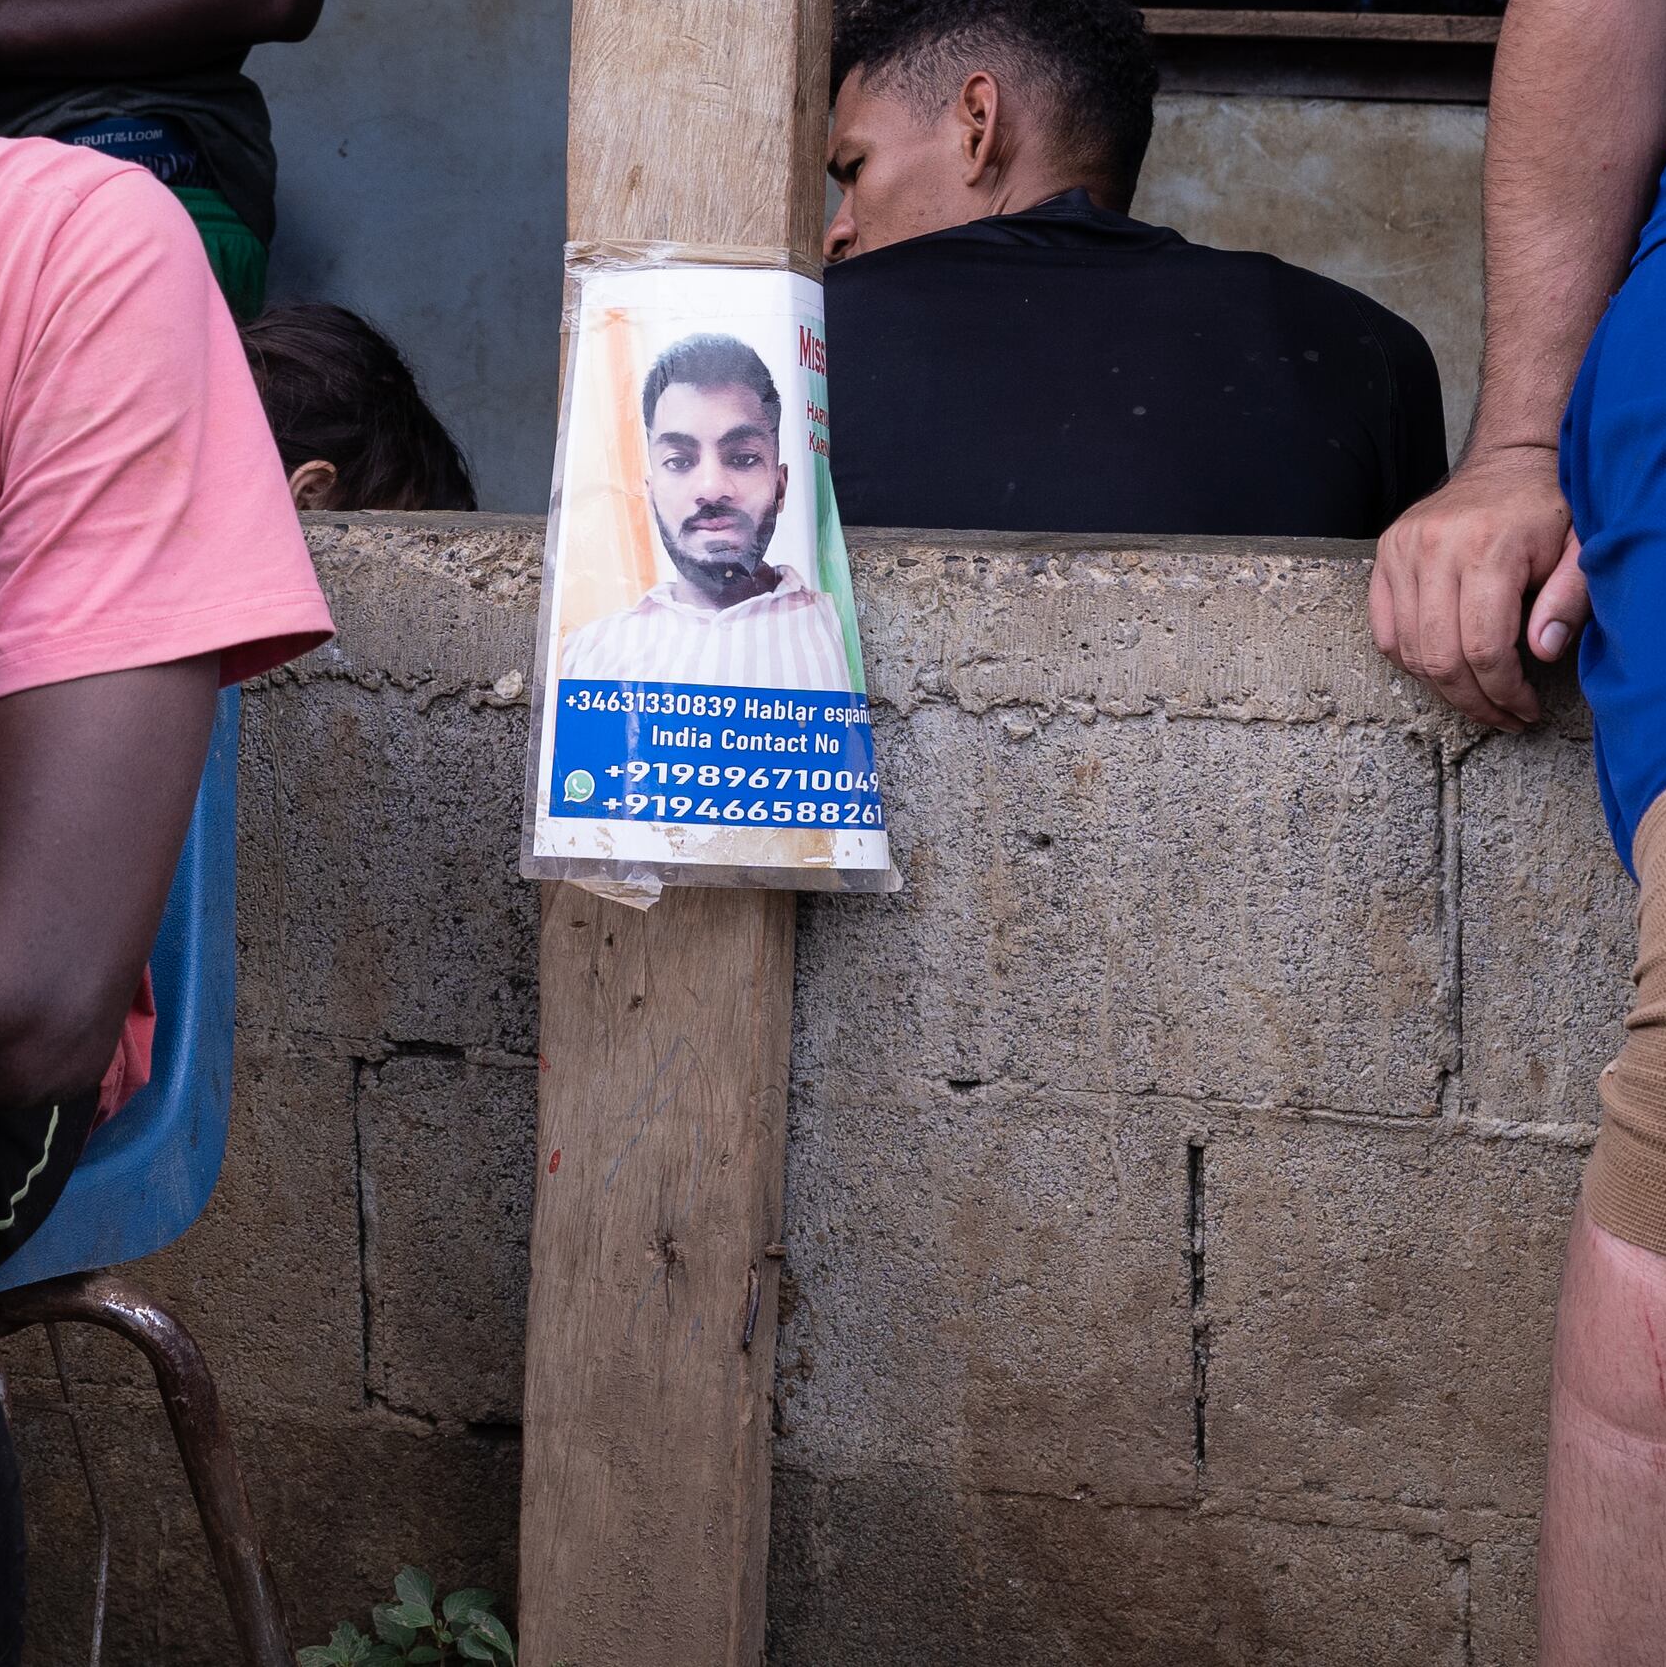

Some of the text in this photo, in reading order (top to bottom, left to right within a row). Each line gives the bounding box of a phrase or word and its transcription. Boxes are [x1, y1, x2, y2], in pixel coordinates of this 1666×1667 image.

[73, 132, 114, 146] FRUIT
[128, 129, 163, 142] LOOM
[565, 689, 737, 718] +34631330839
[744, 698, 818, 723] Hablar
[651, 725, 840, 755] India Contact No
[604, 760, 879, 793] +919896710049
[602, 794, 883, 826] +919466588261
